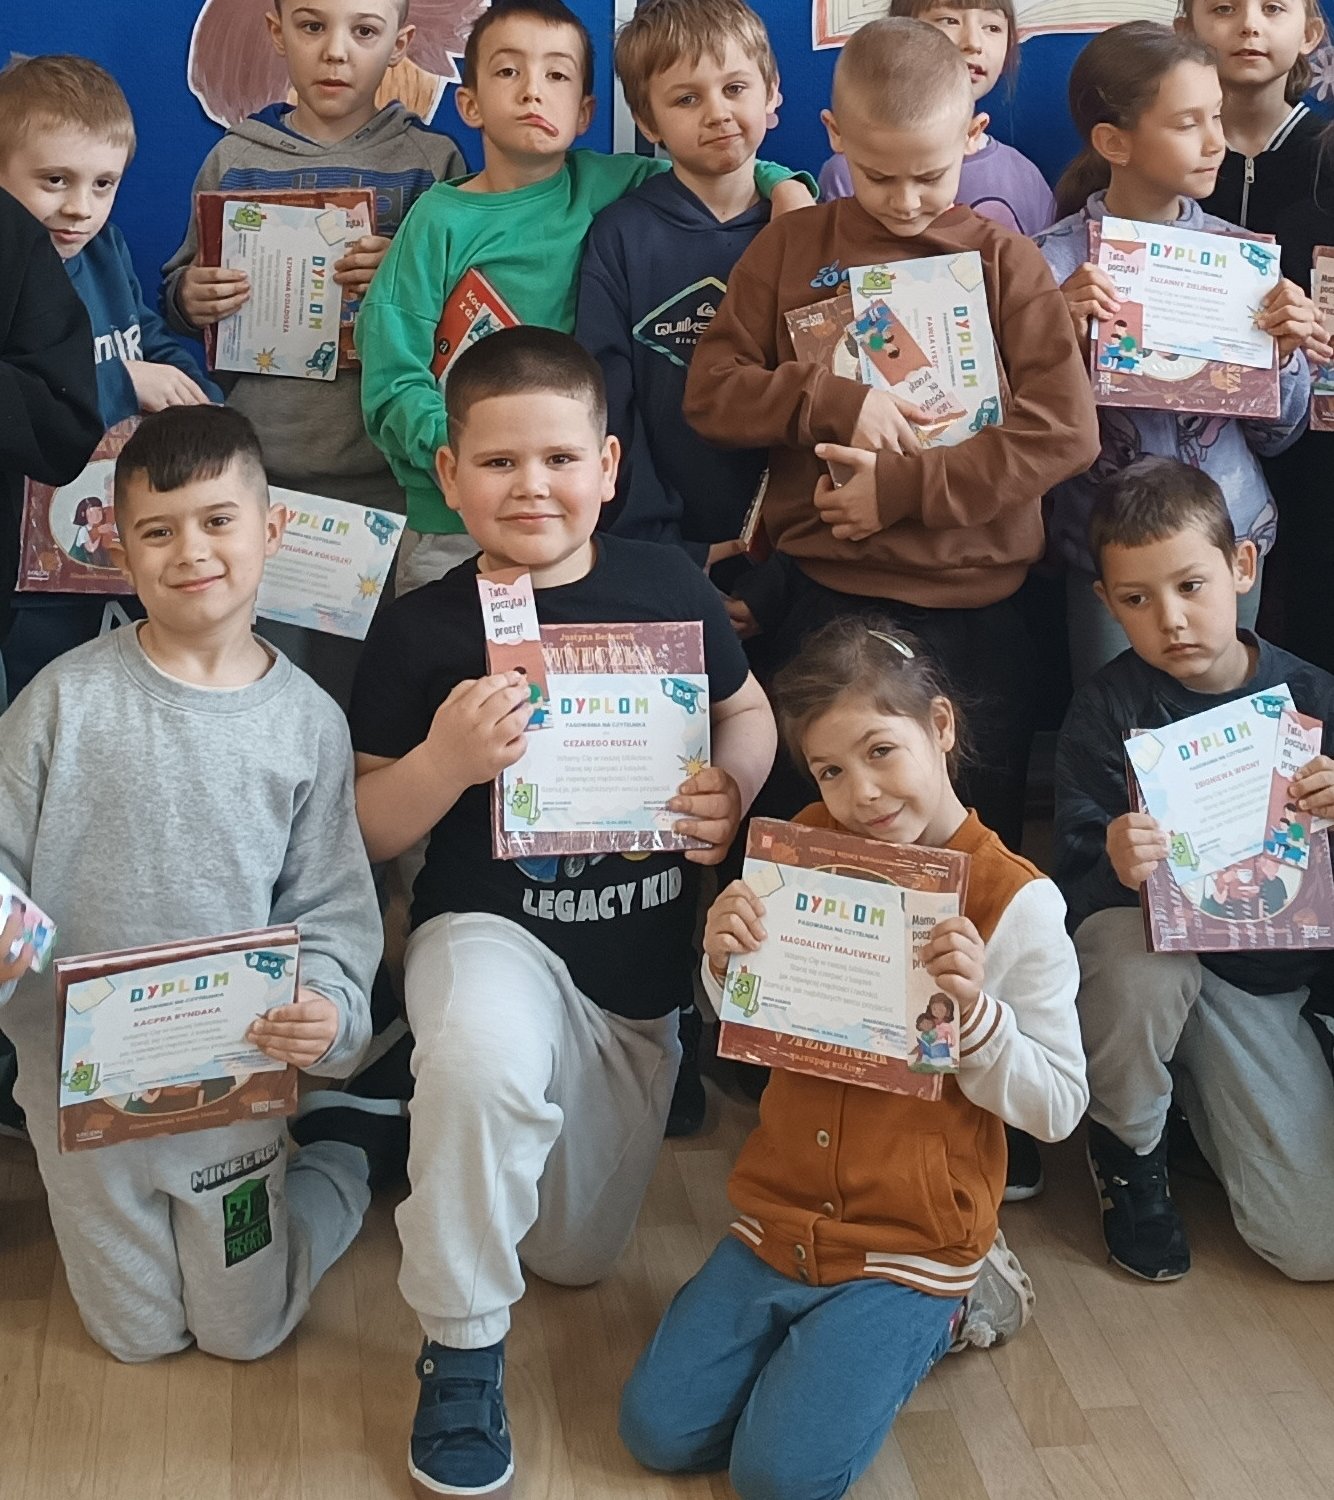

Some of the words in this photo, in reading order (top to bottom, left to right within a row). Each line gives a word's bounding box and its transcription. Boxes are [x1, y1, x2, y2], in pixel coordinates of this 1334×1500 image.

[1150, 242, 1227, 268] DYPLOM
[308, 255, 326, 330] DYPLOM
[953, 306, 979, 388] DYPLOM
[287, 510, 350, 536] YPLOM
[490, 596, 527, 612] poczytaj
[495, 622, 524, 638] proszę!
[559, 632, 593, 642] Justyna
[560, 697, 649, 715] DYPLOM
[1177, 721, 1252, 761] DYPLOM
[1233, 760, 1261, 774] WRONY
[522, 881, 637, 923] LEGACY
[641, 865, 682, 910] KID
[795, 892, 886, 927] DYPLOM
[911, 915, 937, 926] Mamo
[780, 934, 833, 952] MAGDALENY
[834, 946, 891, 964] MAJEWSKIEJ
[912, 931, 931, 942] pocz
[130, 972, 229, 1003] DYPLOM
